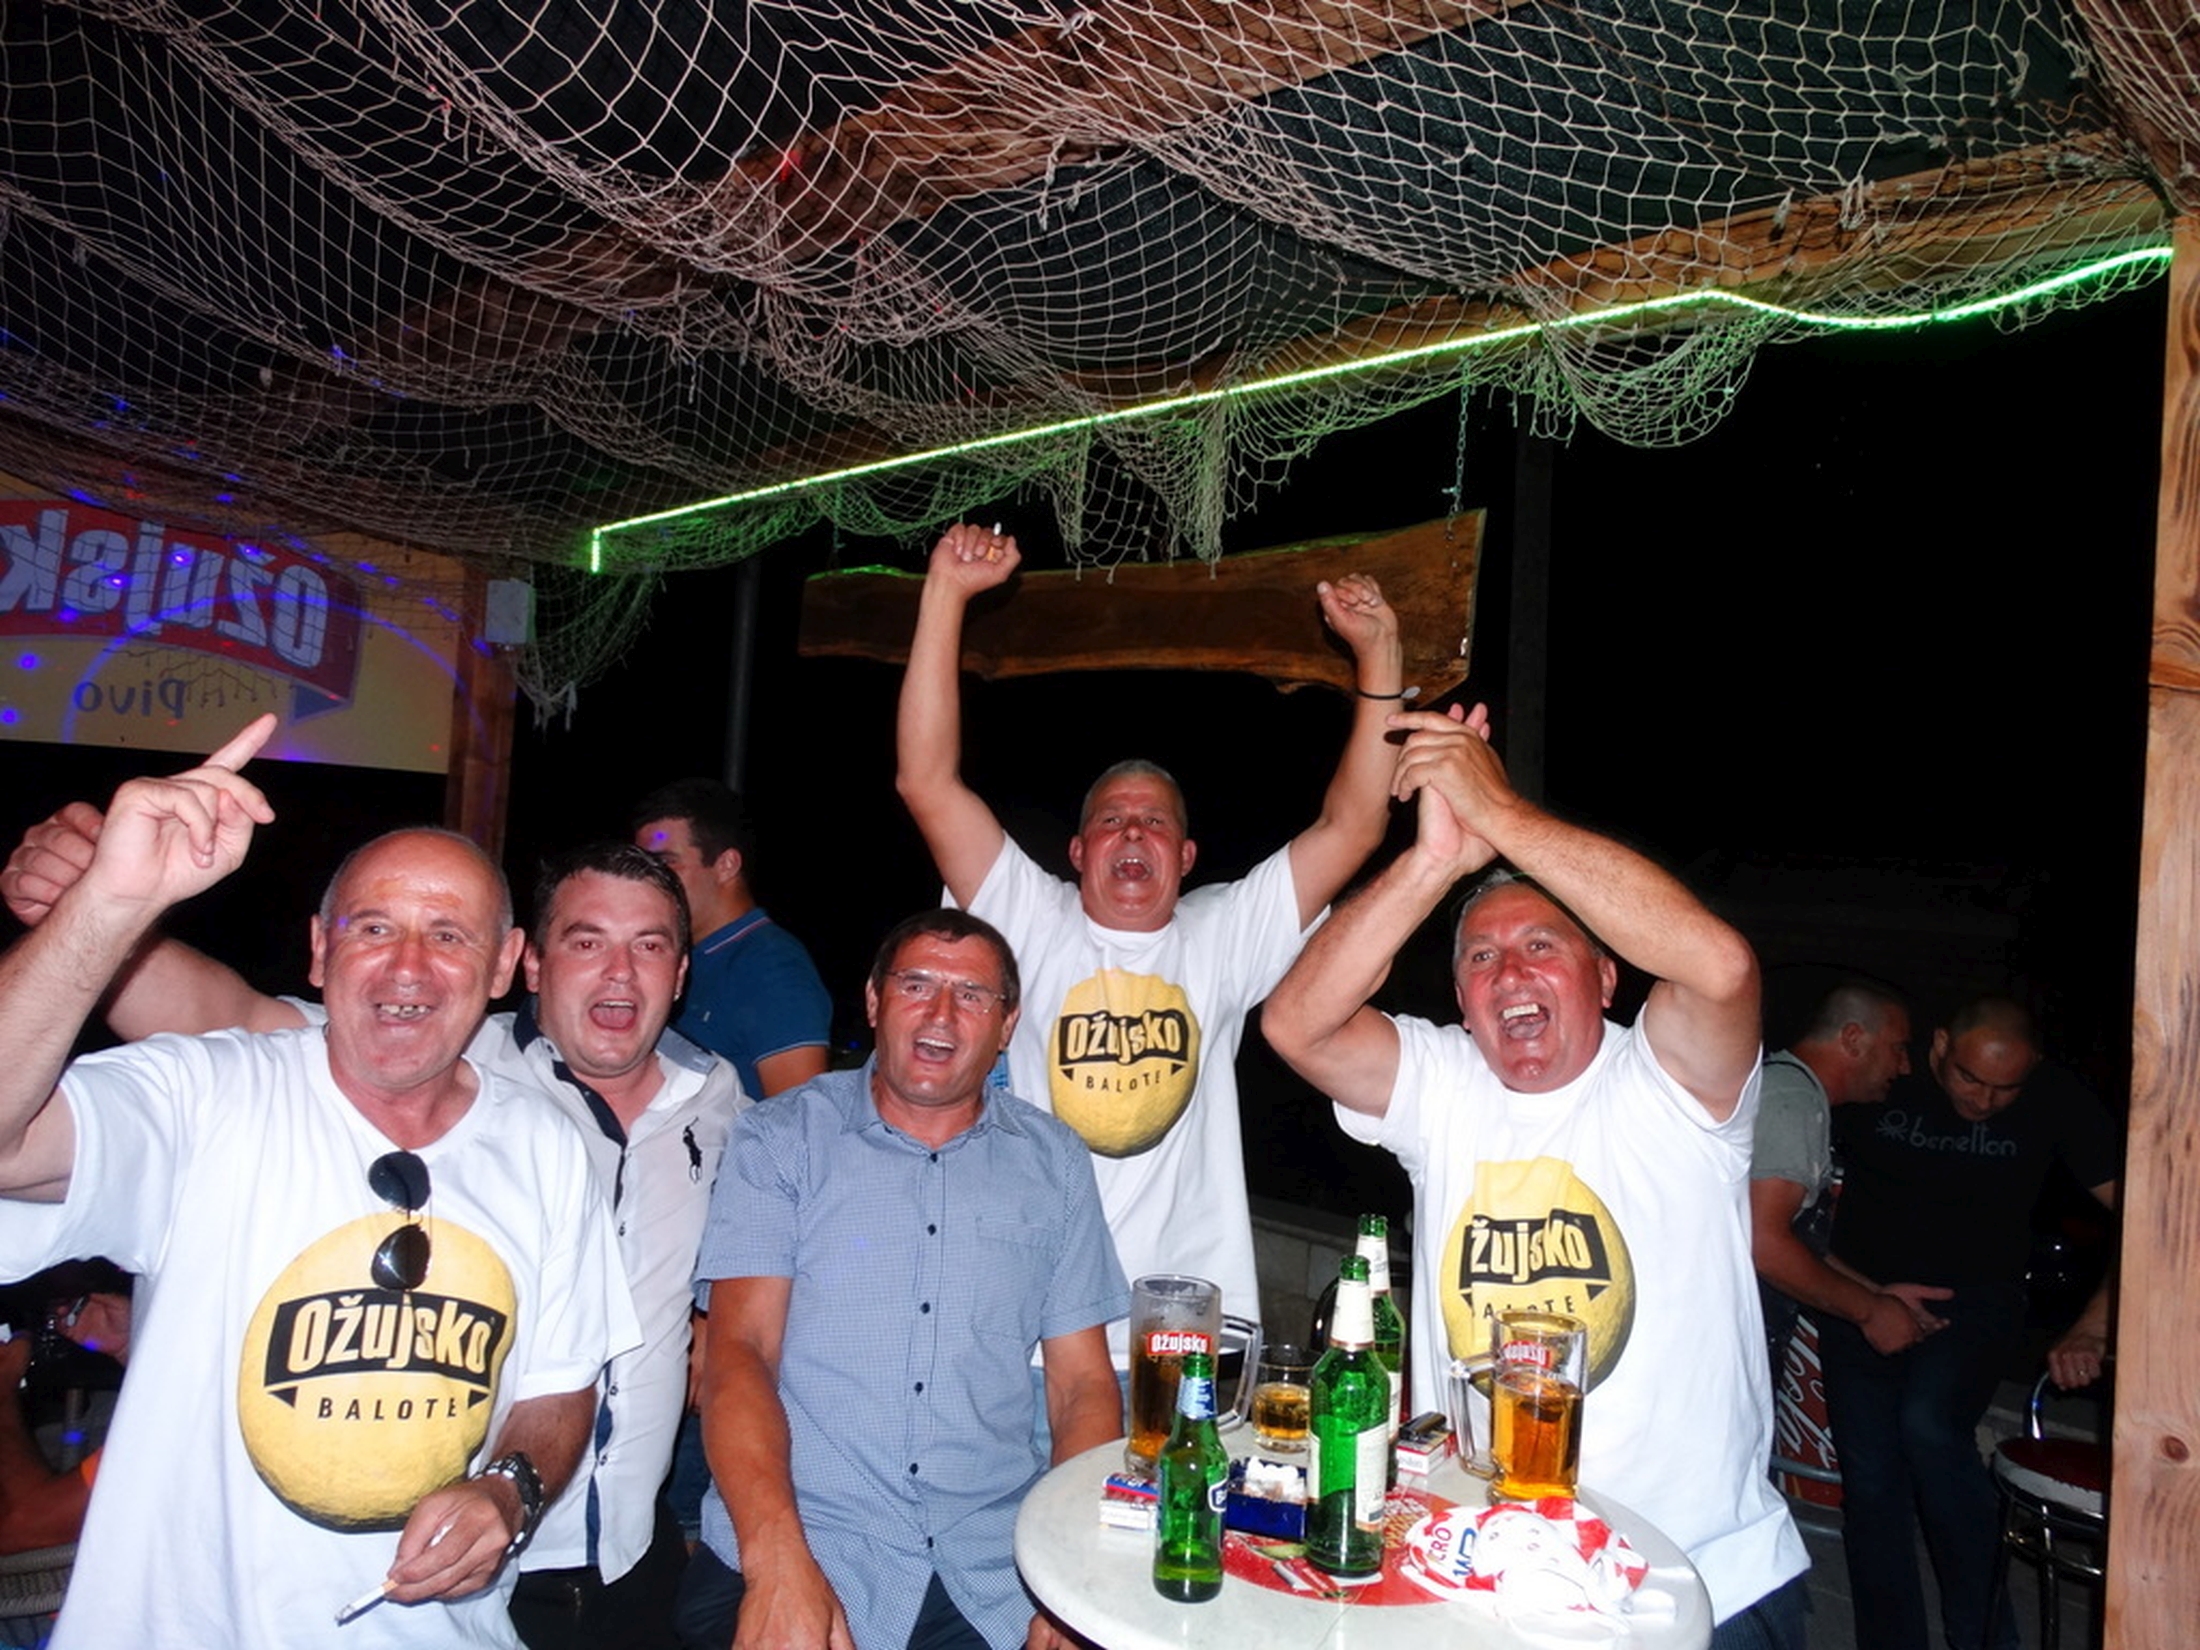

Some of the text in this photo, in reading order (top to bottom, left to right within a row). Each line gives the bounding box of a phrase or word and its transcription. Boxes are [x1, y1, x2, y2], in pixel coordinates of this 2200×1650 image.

[1085, 1070, 1161, 1093] BALOTE
[1908, 1116, 2019, 1157] benetton
[1470, 1217, 1593, 1284] Žujsko
[286, 1293, 492, 1375] Ožujsko
[317, 1396, 458, 1421] BALOTE
